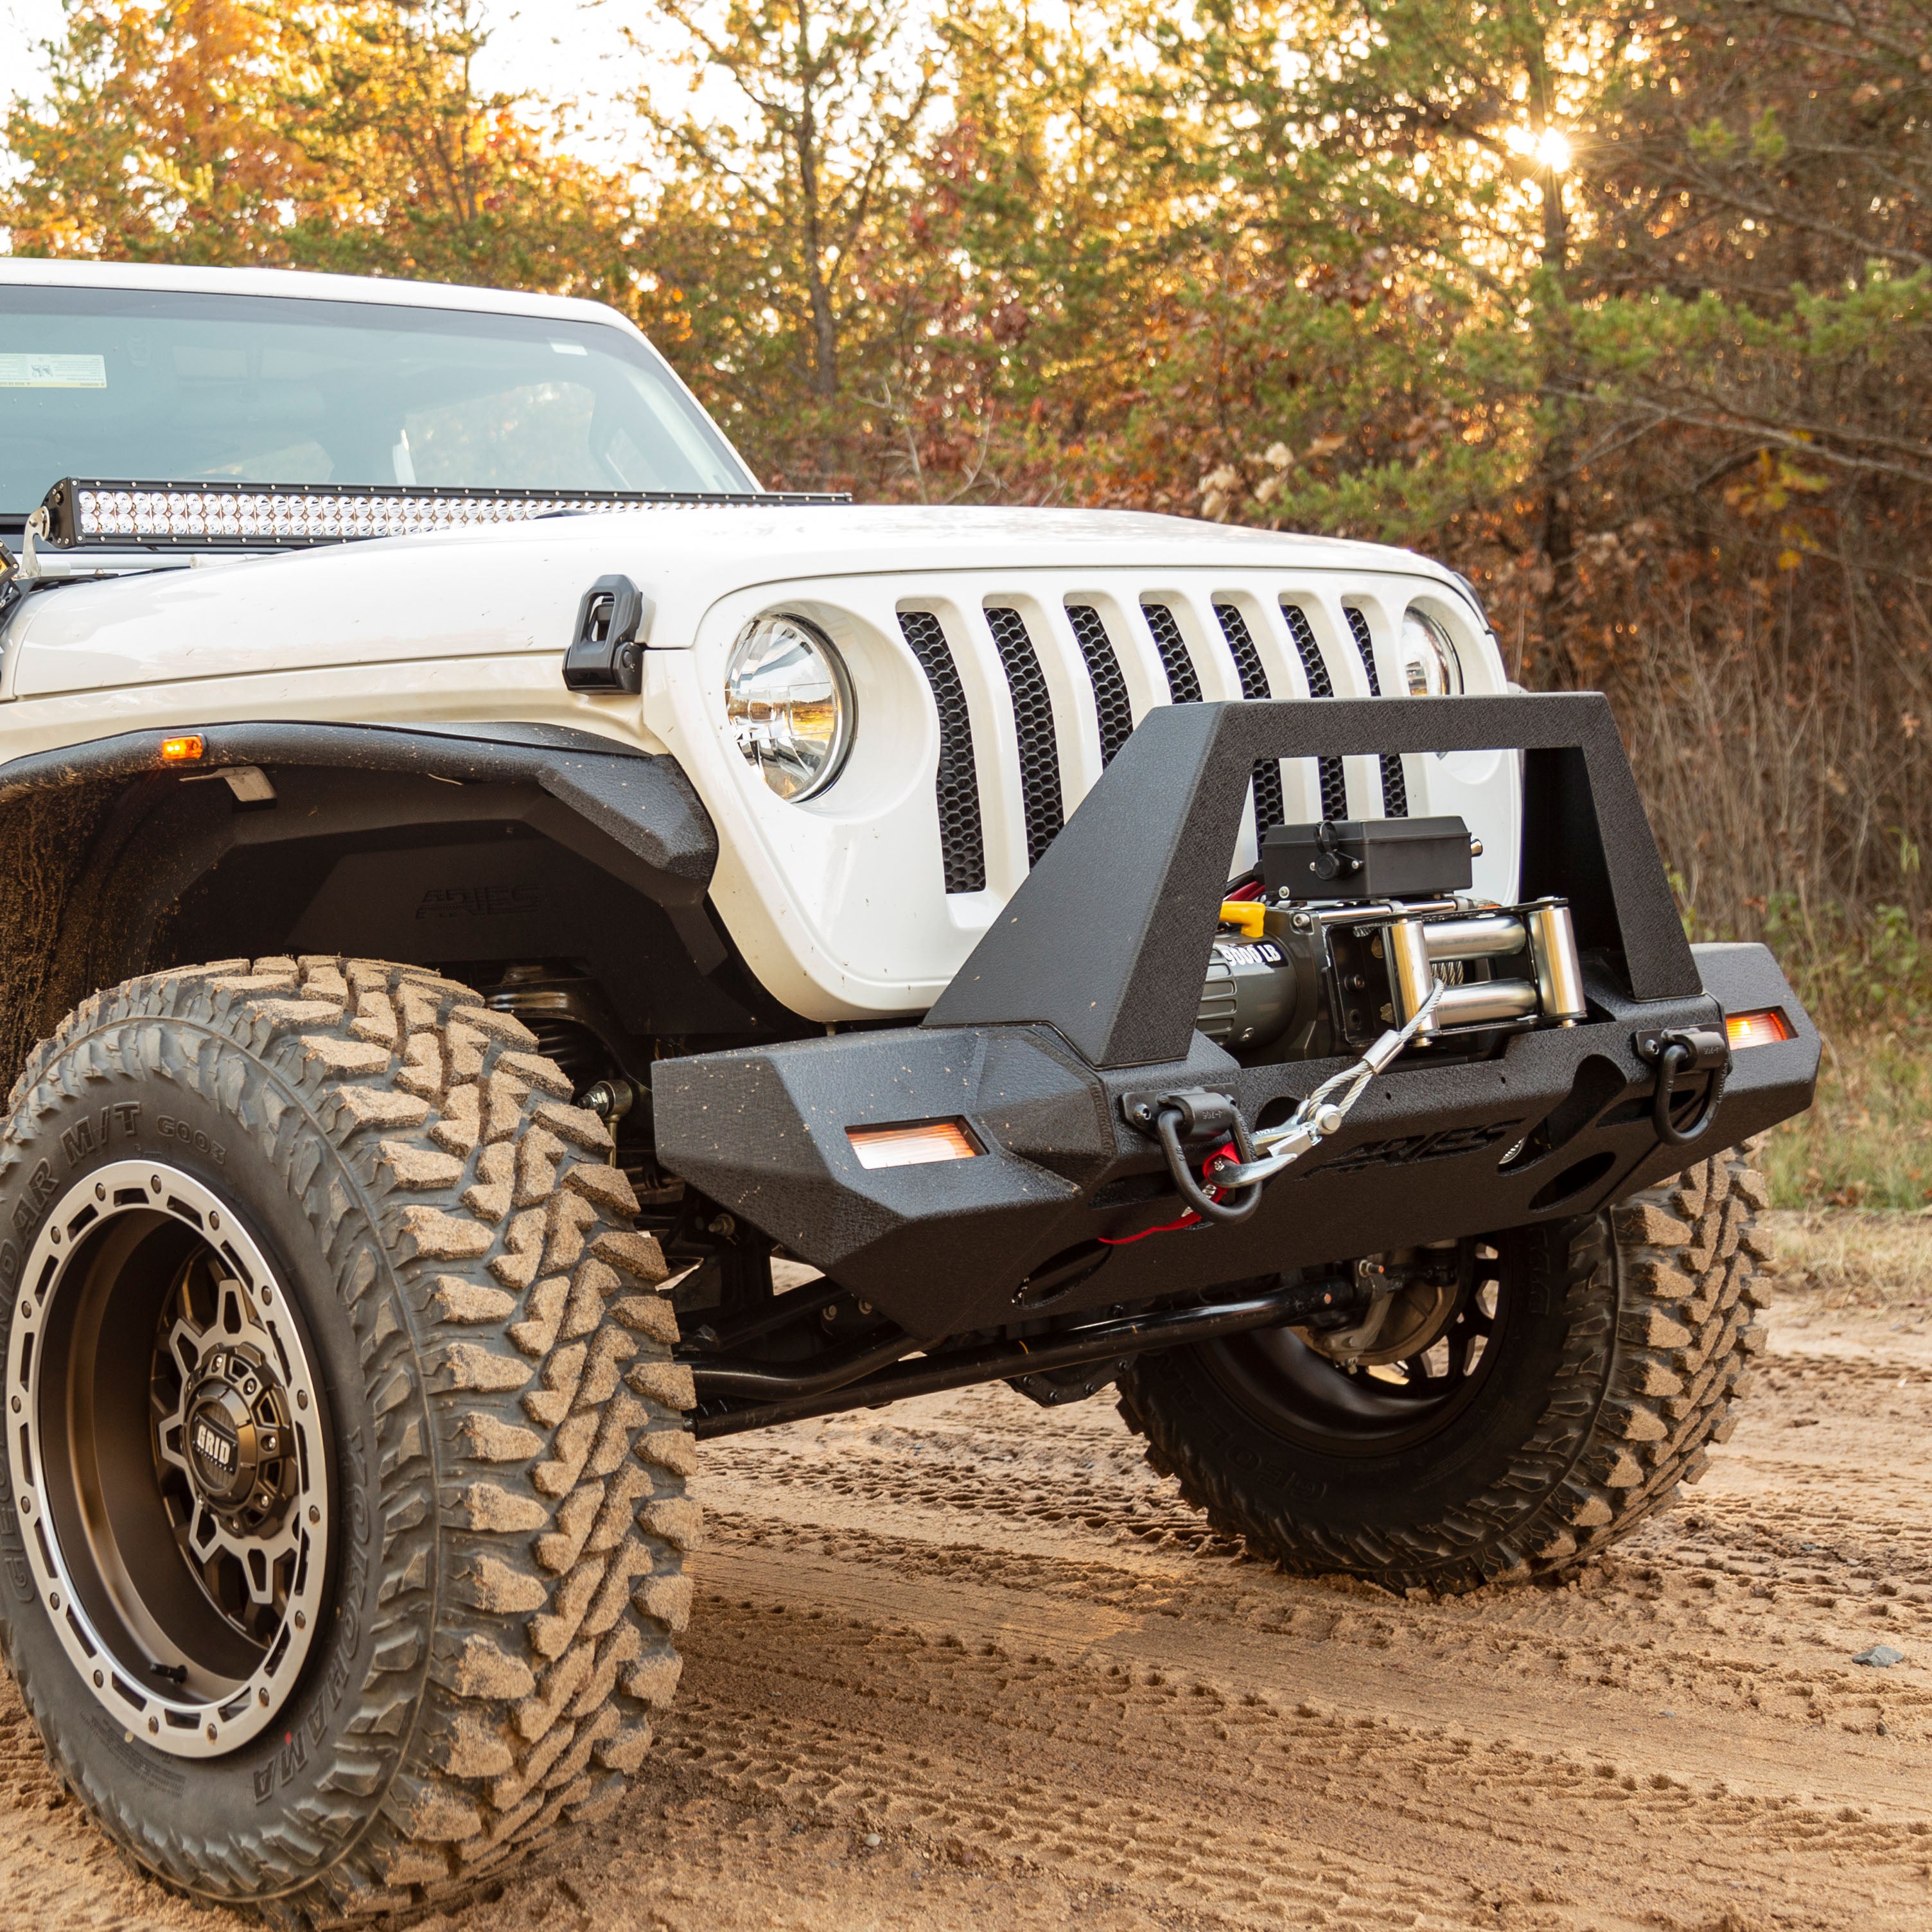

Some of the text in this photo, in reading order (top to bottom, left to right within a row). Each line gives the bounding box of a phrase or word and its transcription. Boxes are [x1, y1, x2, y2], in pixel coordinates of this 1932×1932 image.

[1220, 944, 1281, 966] 9000 LB
[60, 1102, 140, 1168] M/T
[197, 1425, 231, 1465] GRID
[253, 1425, 369, 1806] YOKOHAMA
